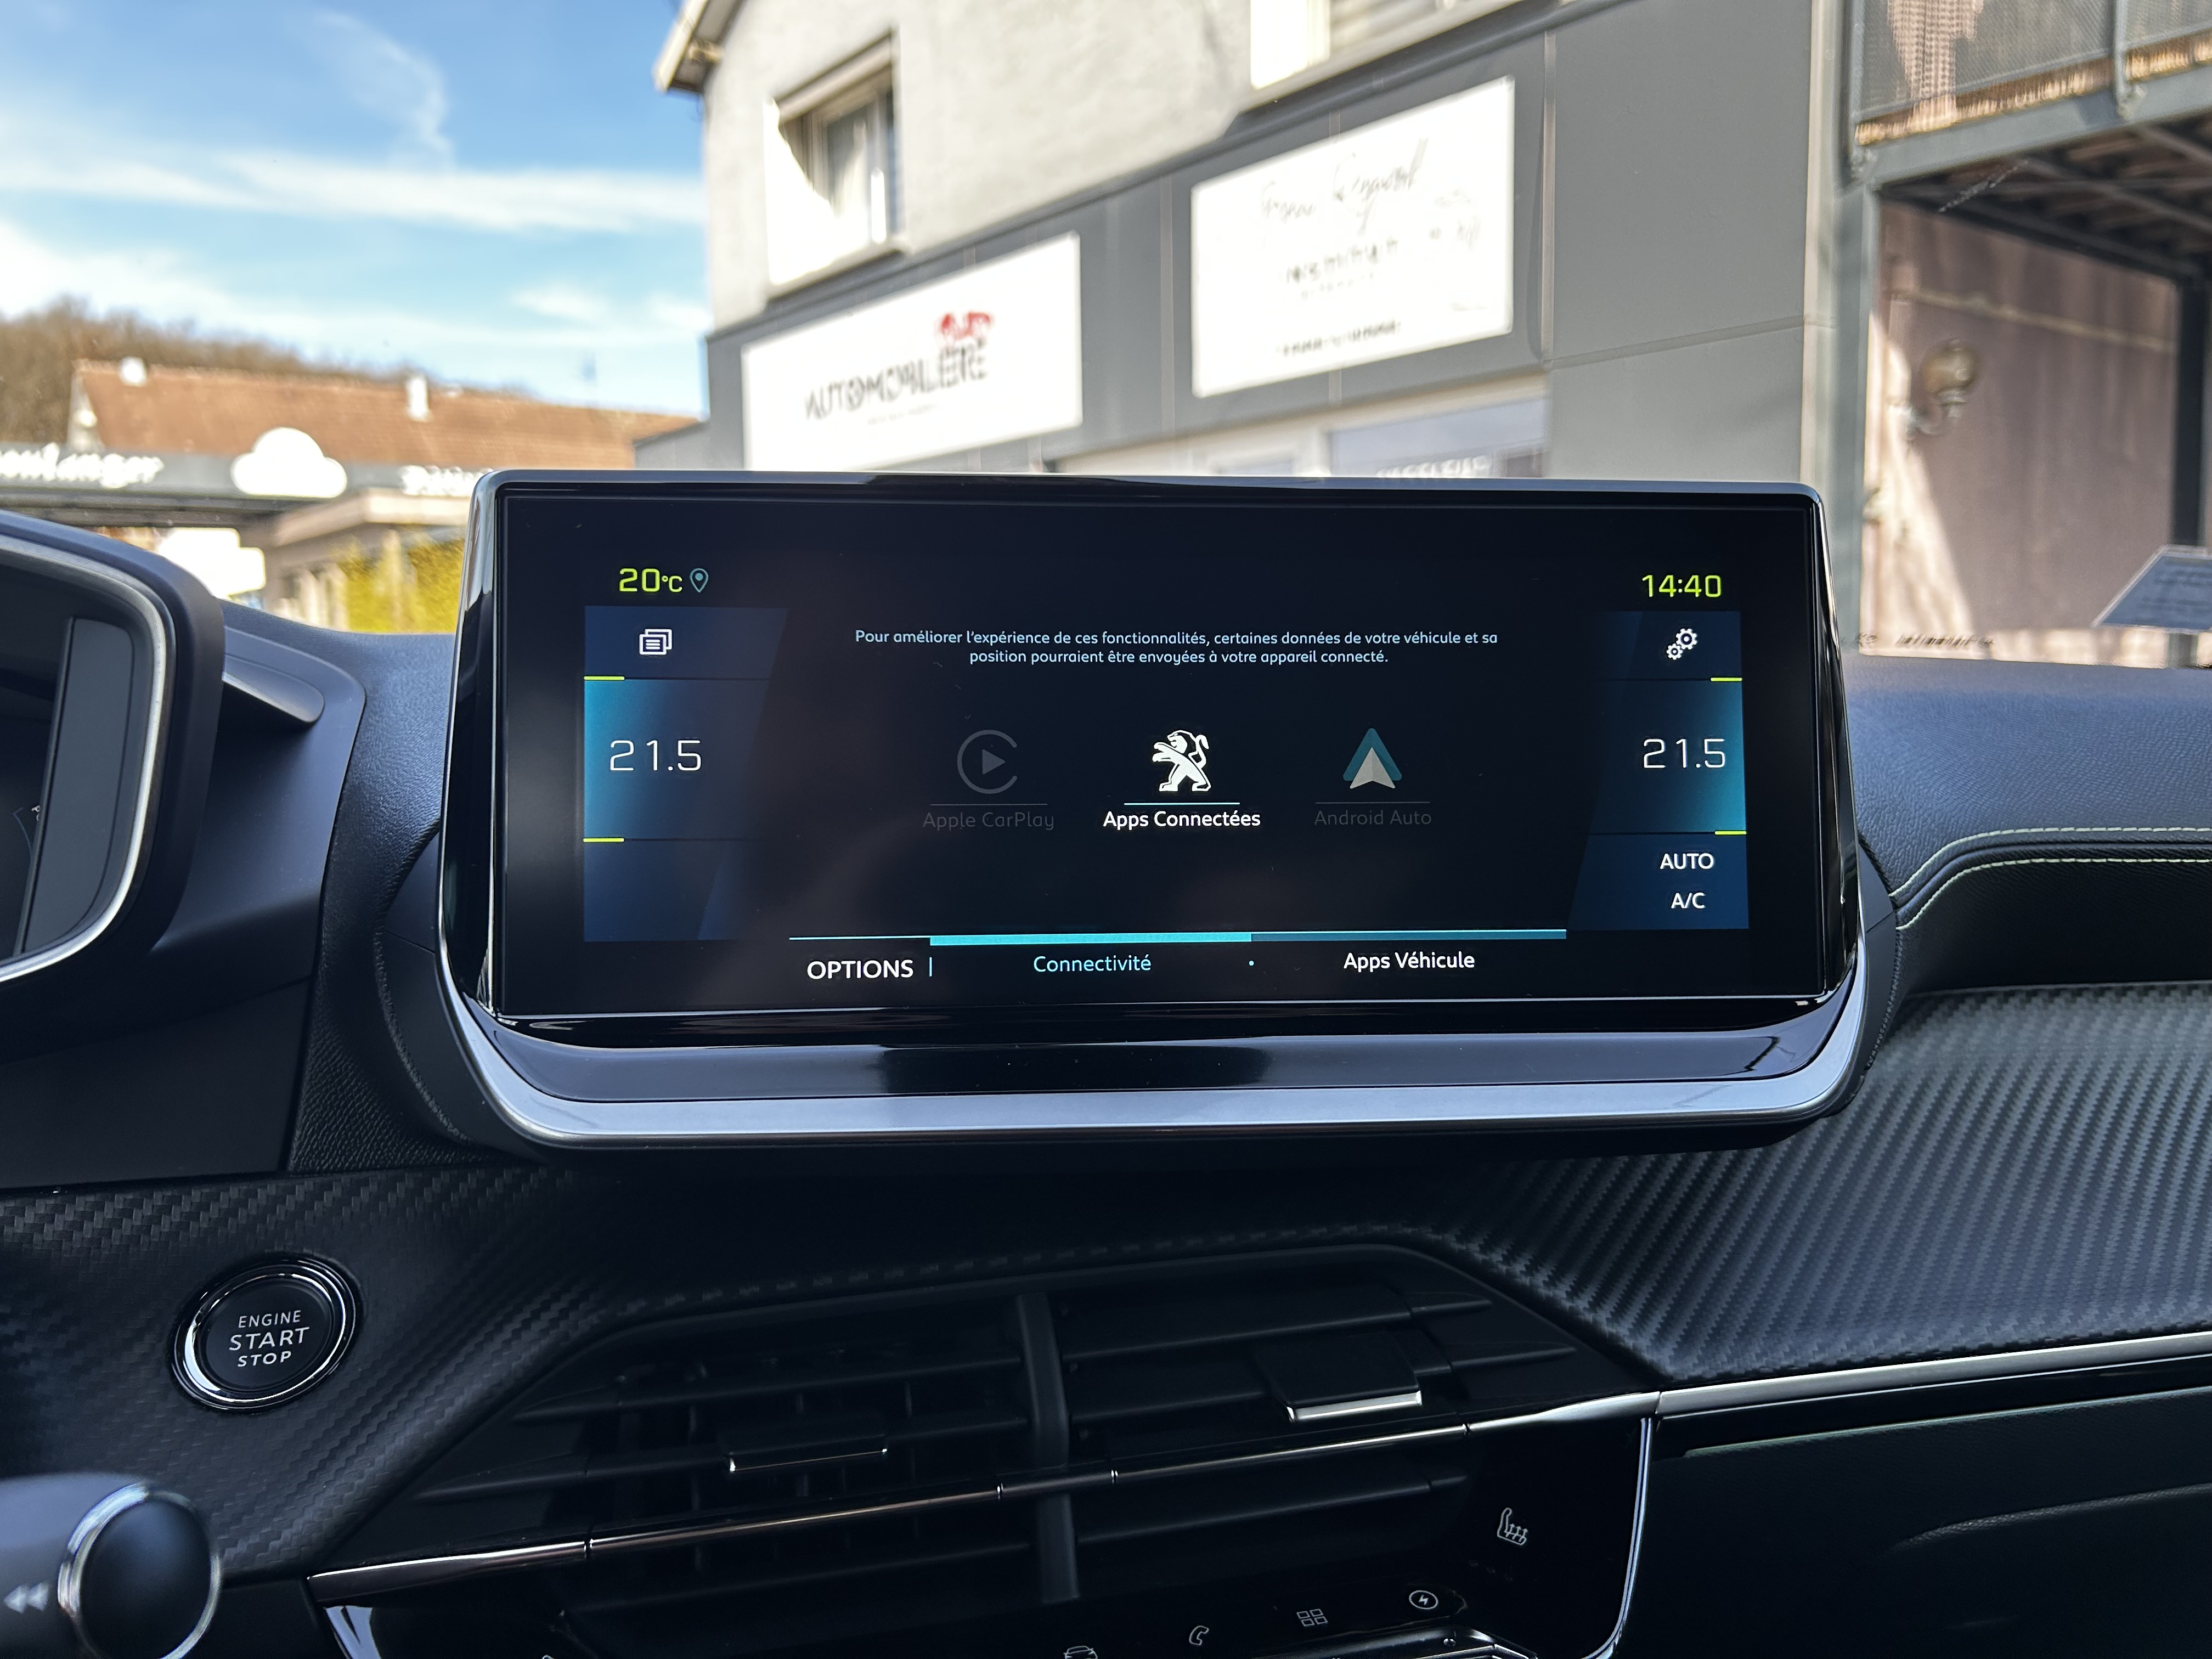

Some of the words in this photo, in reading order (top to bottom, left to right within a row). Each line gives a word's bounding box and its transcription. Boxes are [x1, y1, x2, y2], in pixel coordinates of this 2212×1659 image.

[1642, 574, 1722, 597] 14:40
[855, 629, 890, 642] Pour
[893, 630, 963, 643] améliorer
[967, 630, 1050, 646] l'expérience
[1054, 631, 1071, 644] de
[1075, 634, 1098, 644] ces
[1102, 630, 1210, 647] fonctionnalités,
[1214, 631, 1278, 644] certaines
[1281, 631, 1341, 644] données
[1344, 631, 1362, 644] de
[1364, 632, 1401, 644] votre
[1403, 631, 1461, 644] véhicule
[1465, 632, 1479, 644] et
[1482, 634, 1498, 644] sa
[970, 650, 1026, 665] position
[1031, 650, 1104, 665] pourraient
[1108, 650, 1135, 663] être
[1139, 650, 1205, 665] envoyées
[1209, 650, 1217, 663] à
[1221, 651, 1257, 663] votre
[1261, 650, 1318, 665] appareil
[1321, 650, 1388, 663] connecté.
[610, 740, 701, 771] 21.5
[1644, 738, 1726, 768] 21.5
[922, 811, 976, 831] Apple
[982, 811, 1054, 831] CarPlay
[1103, 811, 1149, 831] Apps
[1154, 810, 1261, 827] Connectées
[1314, 809, 1383, 825] Android
[1390, 810, 1431, 825] Auto
[1660, 853, 1715, 870] AUTO
[1671, 892, 1706, 909] A/C
[806, 959, 913, 980] OPTIONS
[1034, 953, 1152, 972] Connectivité
[1343, 952, 1390, 973] Apps
[1395, 951, 1475, 969] Véhicule
[238, 1310, 301, 1328] ENGINE
[228, 1326, 311, 1351] START
[236, 1350, 292, 1367] STOP
